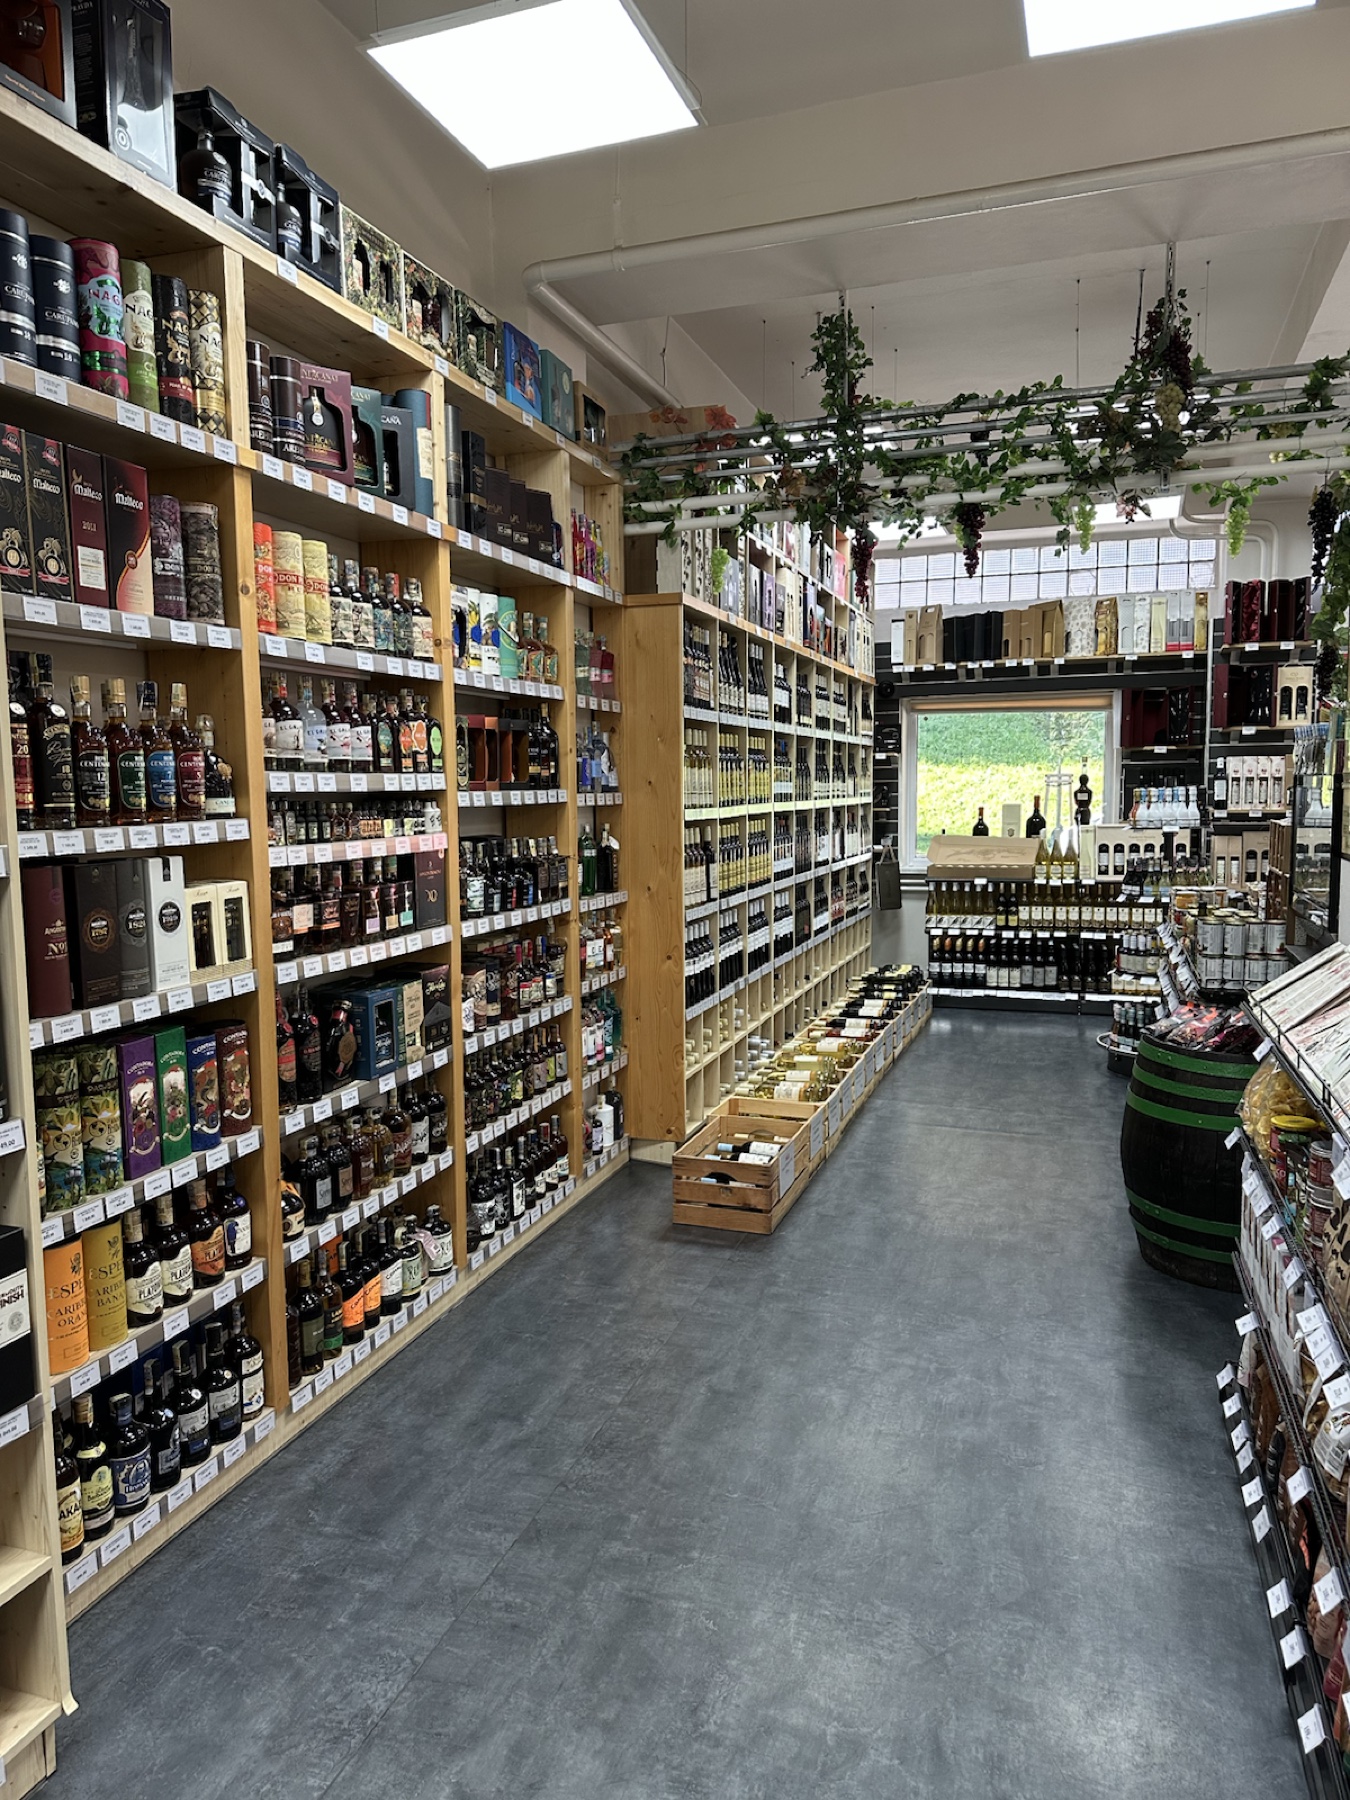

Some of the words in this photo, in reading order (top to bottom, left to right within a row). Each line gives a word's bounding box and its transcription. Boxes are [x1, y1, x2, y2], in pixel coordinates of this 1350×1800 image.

[74, 483, 103, 502] Malteco
[115, 492, 144, 510] Malteco
[279, 574, 297, 584] DON
[16, 744, 29, 755] 20
[97, 771, 107, 781] 12
[137, 771, 144, 781] 9
[196, 771, 202, 779] 5
